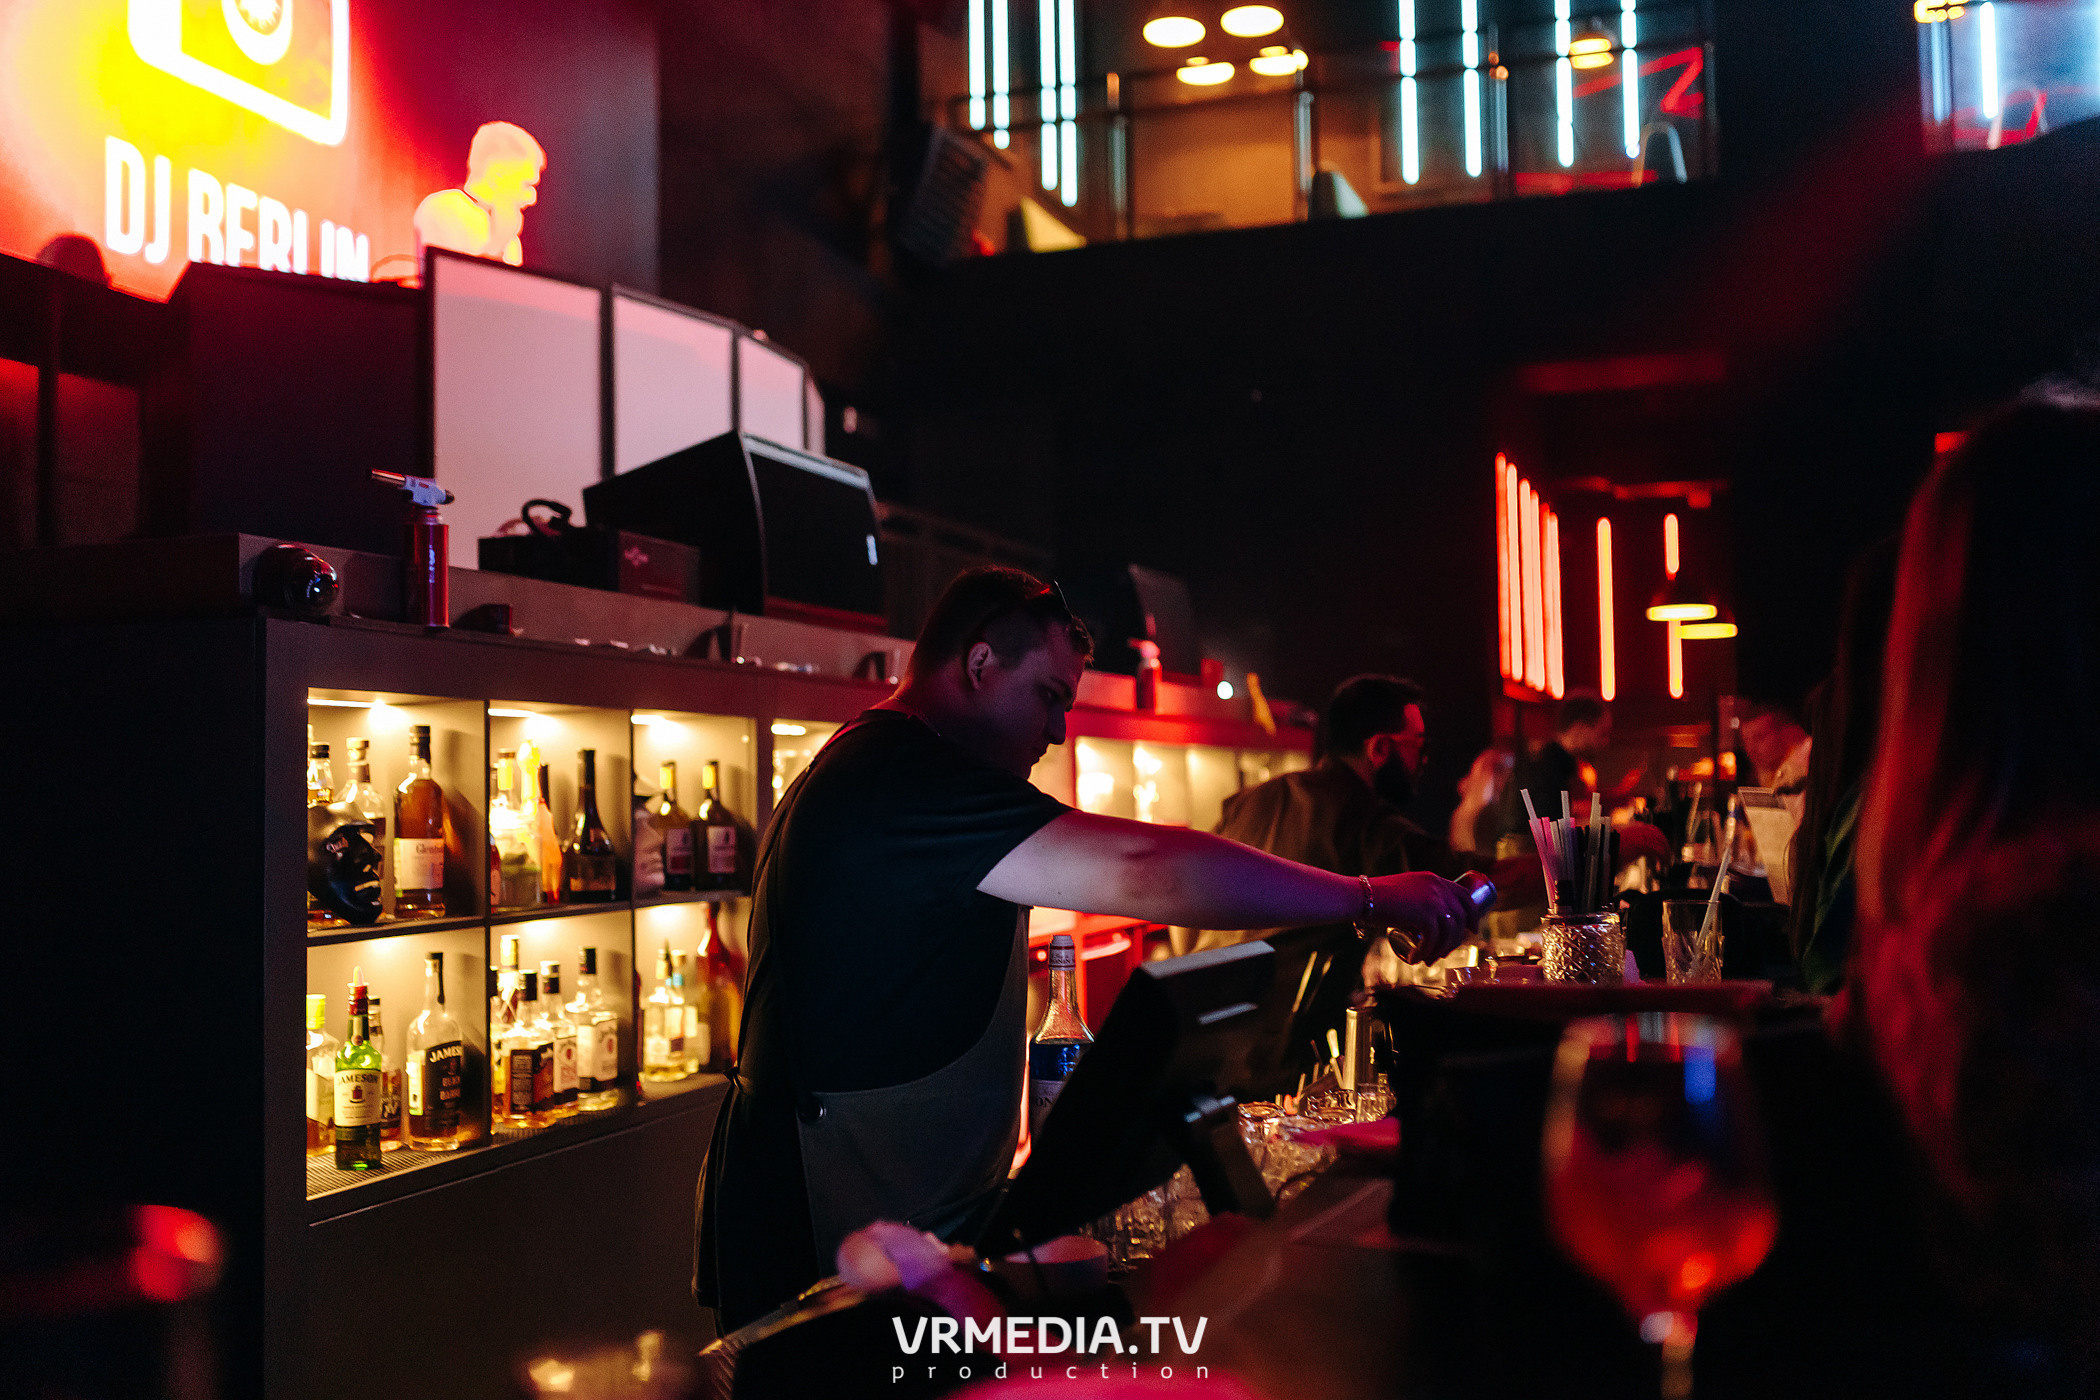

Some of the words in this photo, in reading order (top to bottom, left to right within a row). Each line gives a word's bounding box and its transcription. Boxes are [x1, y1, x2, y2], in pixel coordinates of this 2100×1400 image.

[105, 135, 172, 264] DJ
[188, 167, 370, 283] BERLIN
[338, 1073, 378, 1085] AMESON
